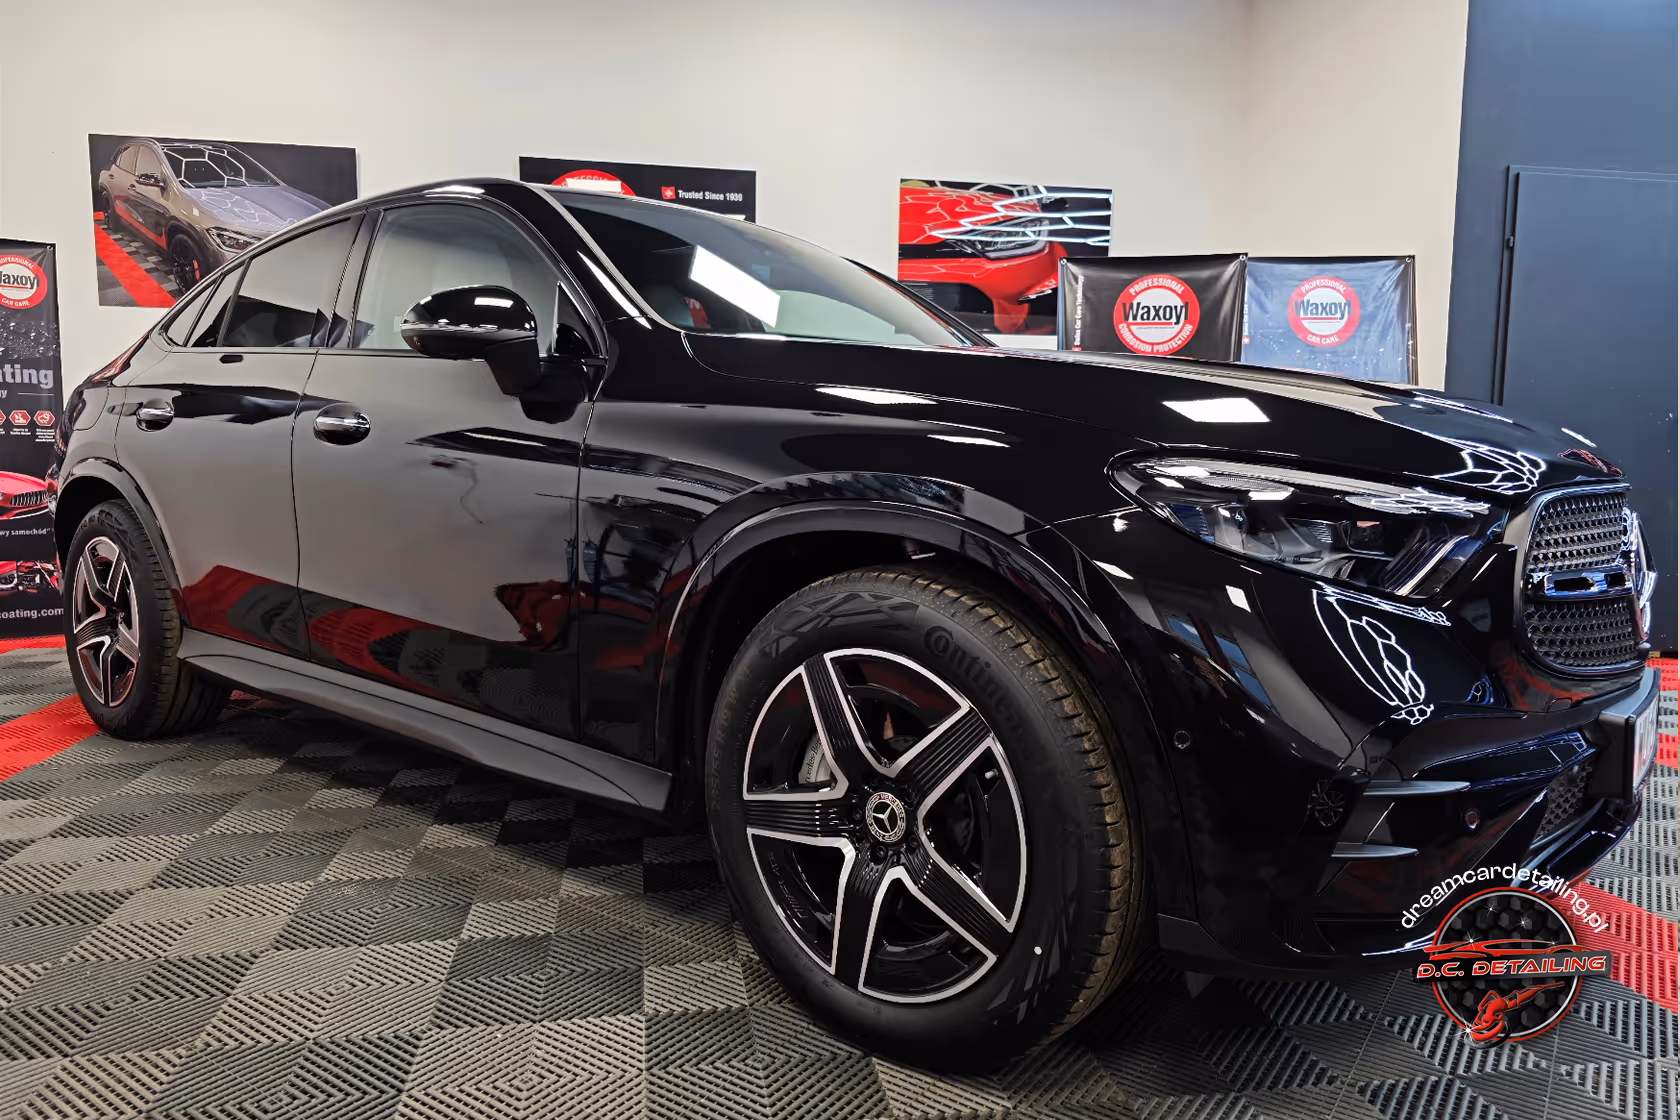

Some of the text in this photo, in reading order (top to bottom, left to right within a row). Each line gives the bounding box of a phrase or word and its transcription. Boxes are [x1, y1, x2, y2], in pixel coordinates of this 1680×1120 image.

[677, 189, 743, 202] Trusted Since 1939
[0, 270, 40, 290] axoyl
[1128, 277, 1185, 296] PROFESSIONAL
[1300, 278, 1347, 294] PROFESSIONAL
[1121, 301, 1189, 326] Waxoyl
[1294, 298, 1352, 321] Waxoyl
[1118, 322, 1193, 353] CORROSION PROTECTION
[1306, 333, 1340, 345] CAR CARE
[0, 607, 65, 619] oating.com
